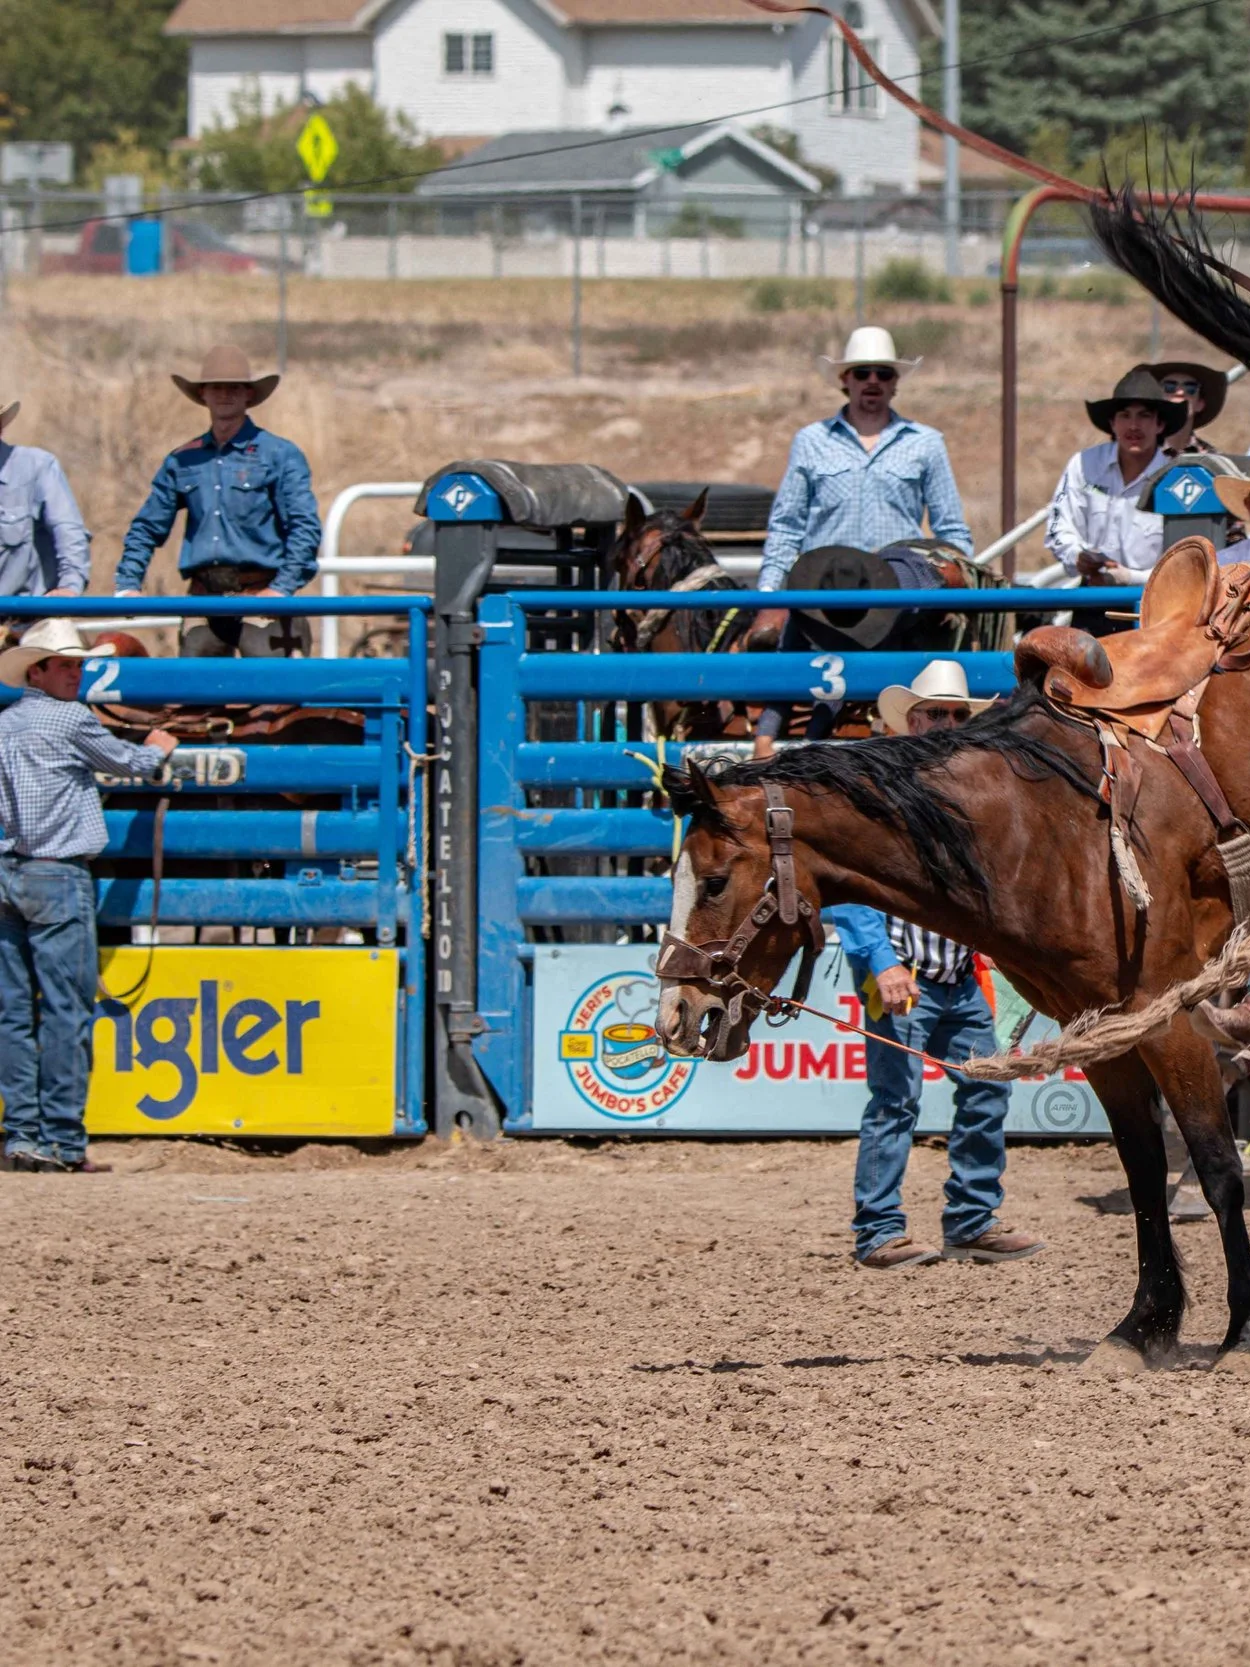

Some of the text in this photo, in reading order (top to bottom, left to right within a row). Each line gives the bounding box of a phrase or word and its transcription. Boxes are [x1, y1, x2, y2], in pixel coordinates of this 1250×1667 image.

[85, 660, 122, 702] 2
[809, 654, 847, 700] 3
[575, 986, 612, 1029] JERI'S
[89, 980, 320, 1120] ngler
[576, 1064, 689, 1113] JUMBO'S CAFE
